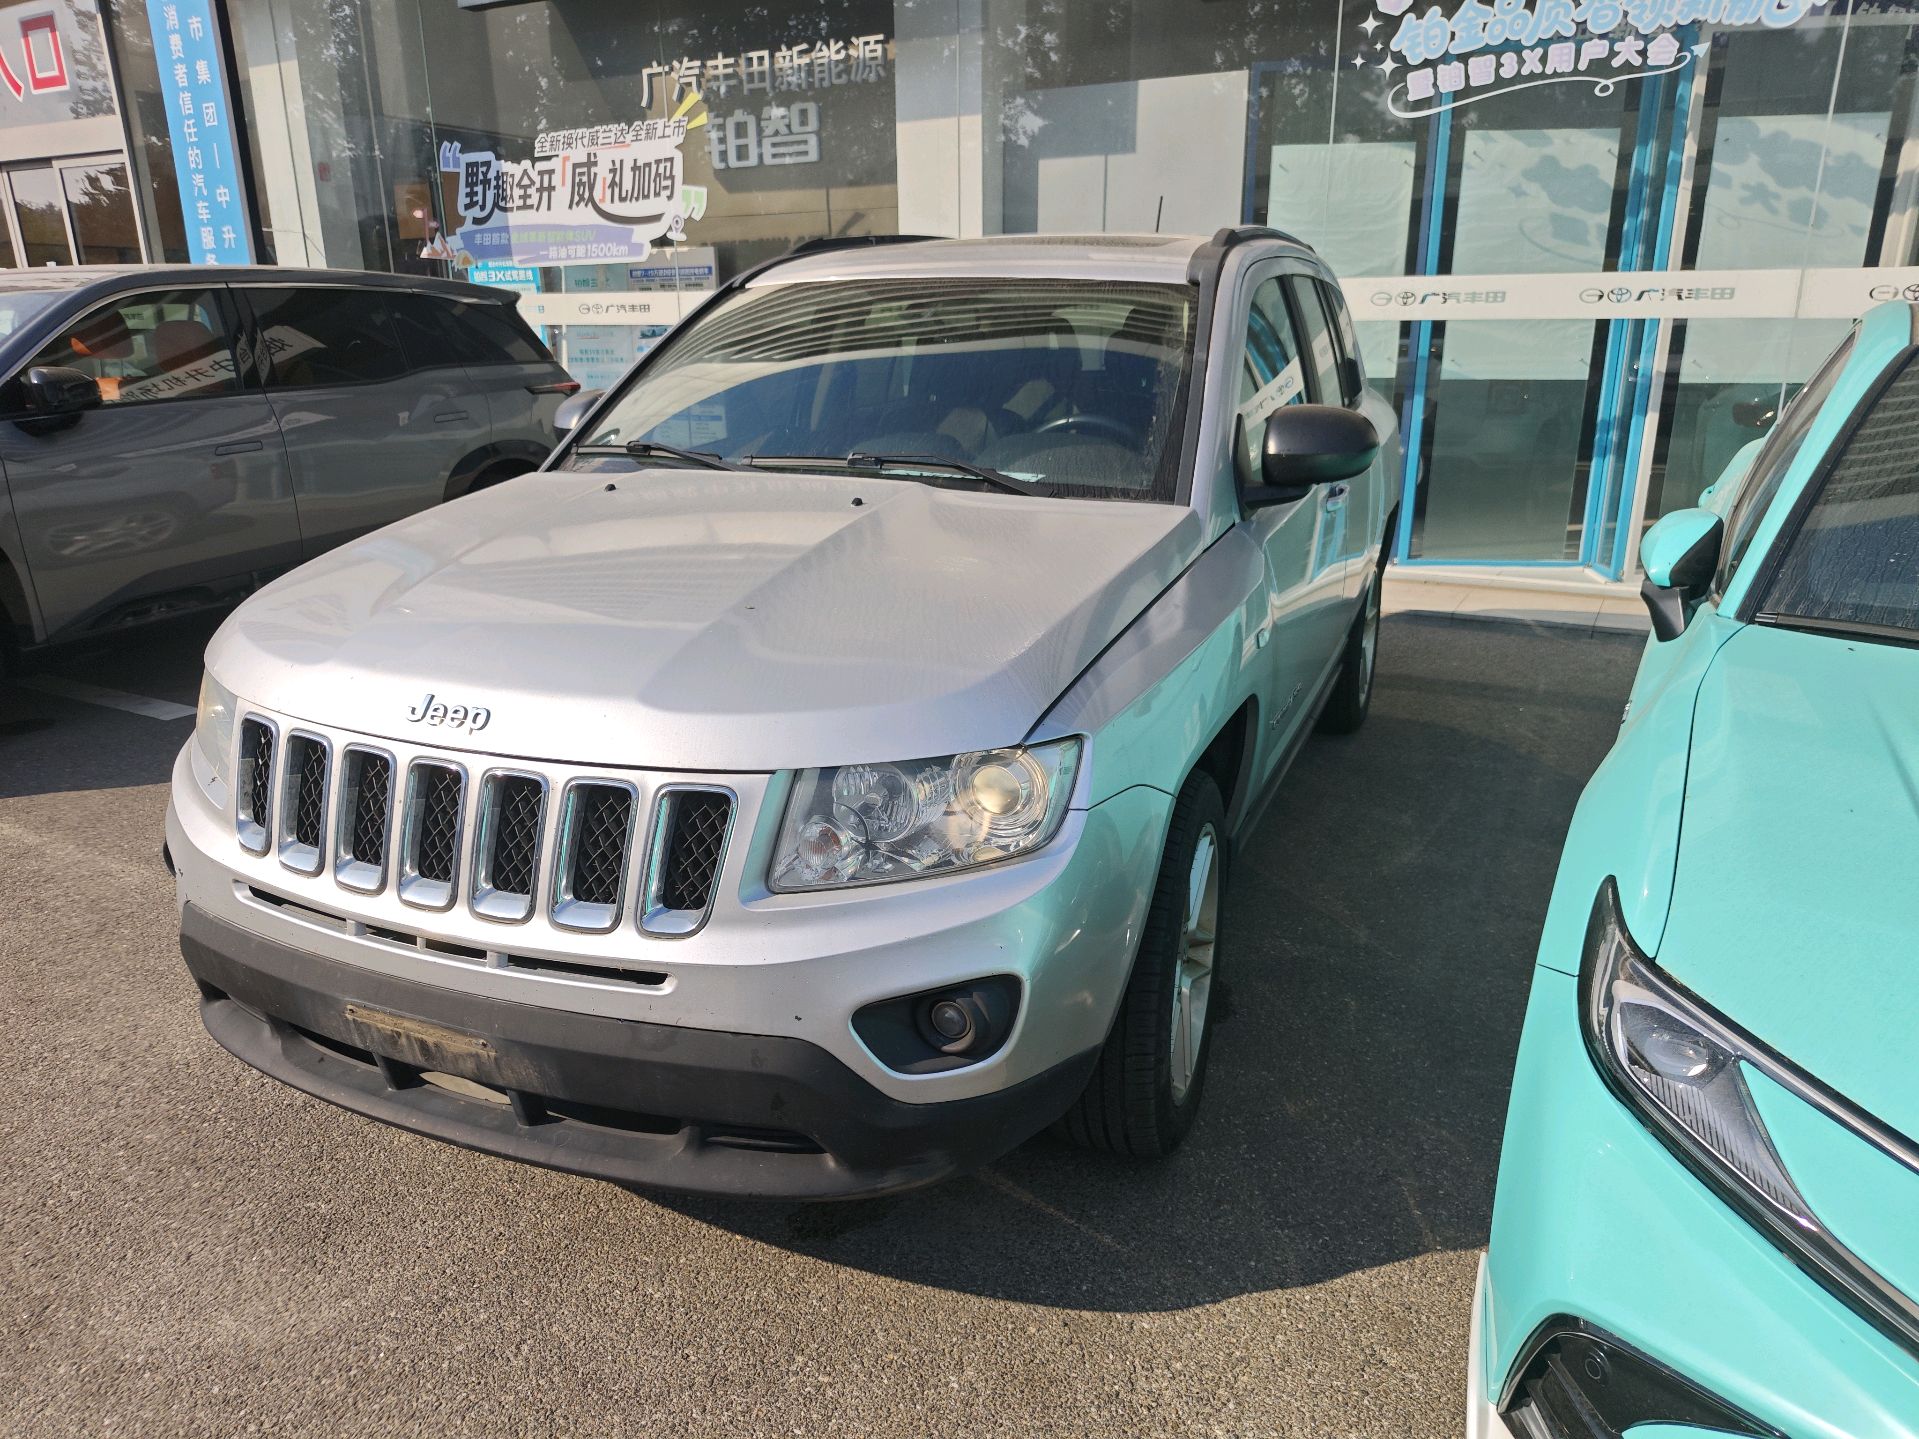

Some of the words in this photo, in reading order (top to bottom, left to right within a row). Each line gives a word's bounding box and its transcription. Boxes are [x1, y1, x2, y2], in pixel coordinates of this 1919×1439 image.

[640, 34, 886, 110] 广汽丰田新能源
[536, 125, 629, 155] 全新换代威兰达
[630, 117, 687, 143] 全新上市
[705, 102, 820, 170] 铂智
[605, 303, 651, 314] 广汽丰田
[1418, 291, 1507, 304] 广汽丰田
[1634, 287, 1735, 301] 广汽丰田
[406, 693, 491, 736] Jeep
